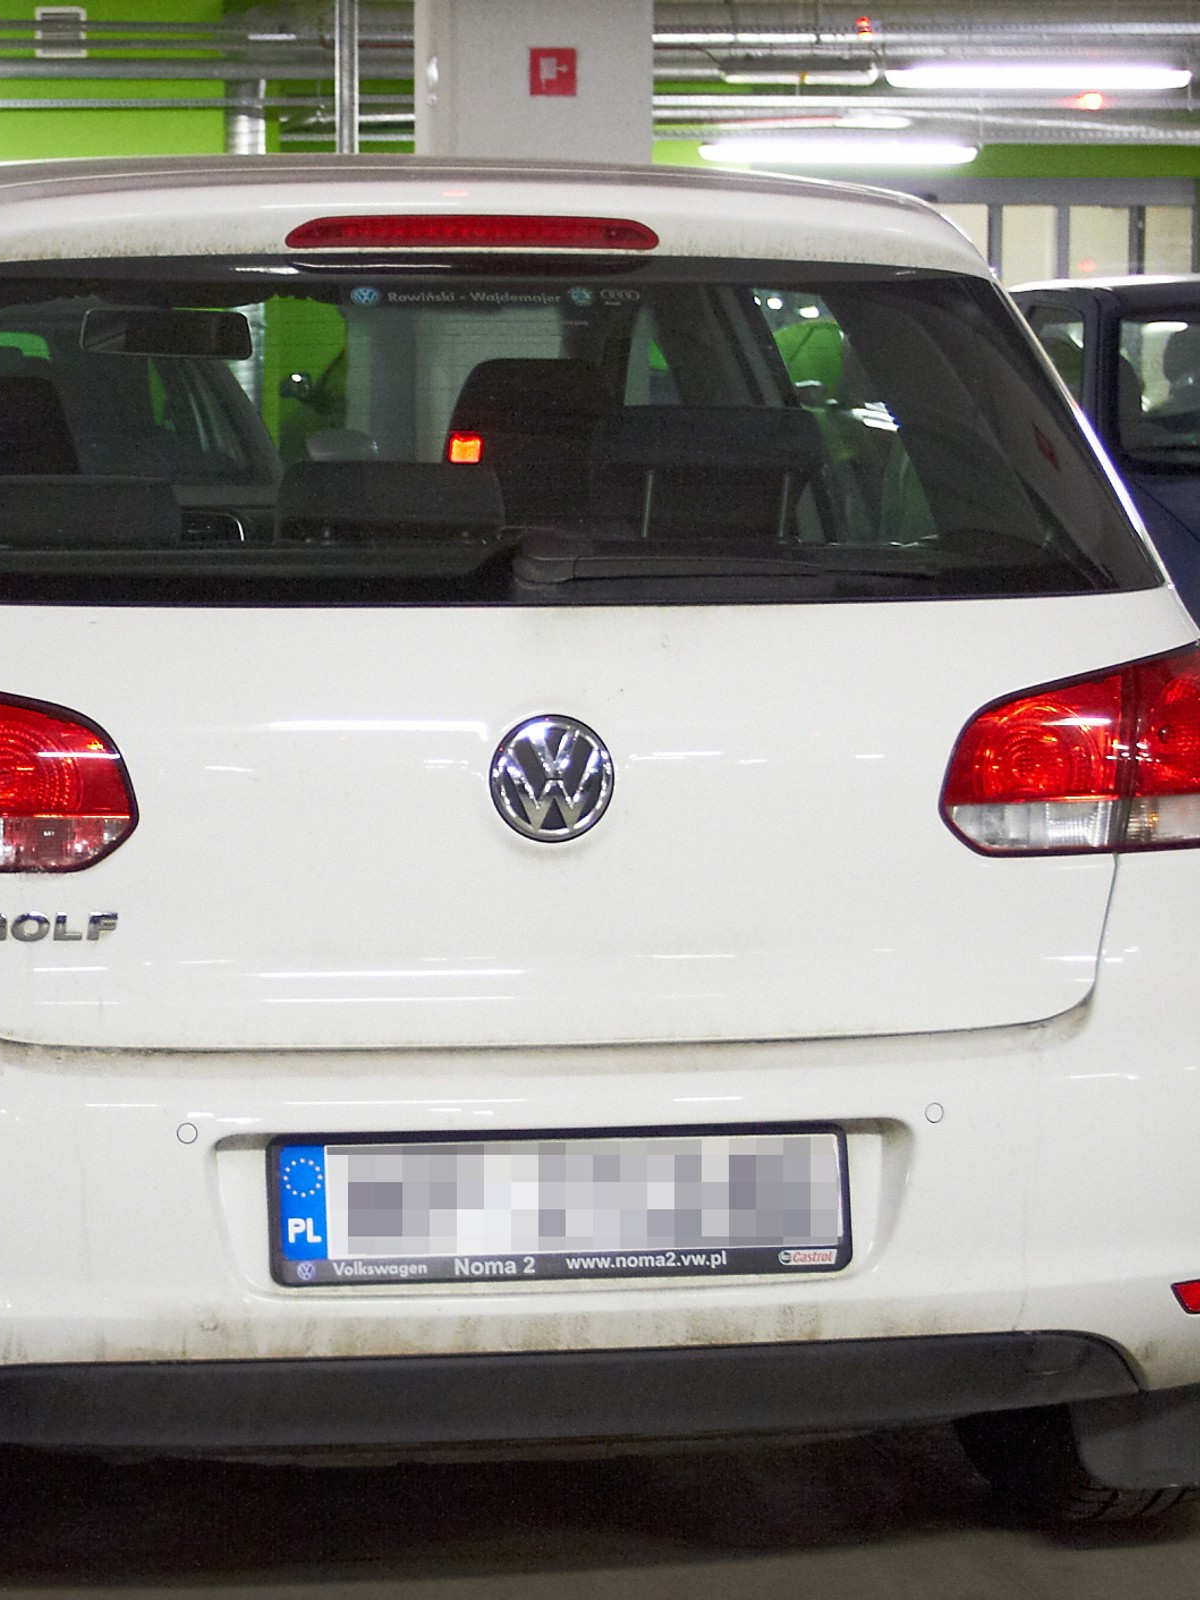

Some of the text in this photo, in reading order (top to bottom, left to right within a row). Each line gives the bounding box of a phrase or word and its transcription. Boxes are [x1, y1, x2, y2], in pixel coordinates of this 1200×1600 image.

[494, 720, 609, 837] VW
[287, 1217, 322, 1244] PL
[454, 1256, 536, 1276] Noma 2
[565, 1250, 728, 1269] www.noma2.vw.pl
[790, 1250, 833, 1264] Castrol
[332, 1261, 428, 1278] Volkswagen
